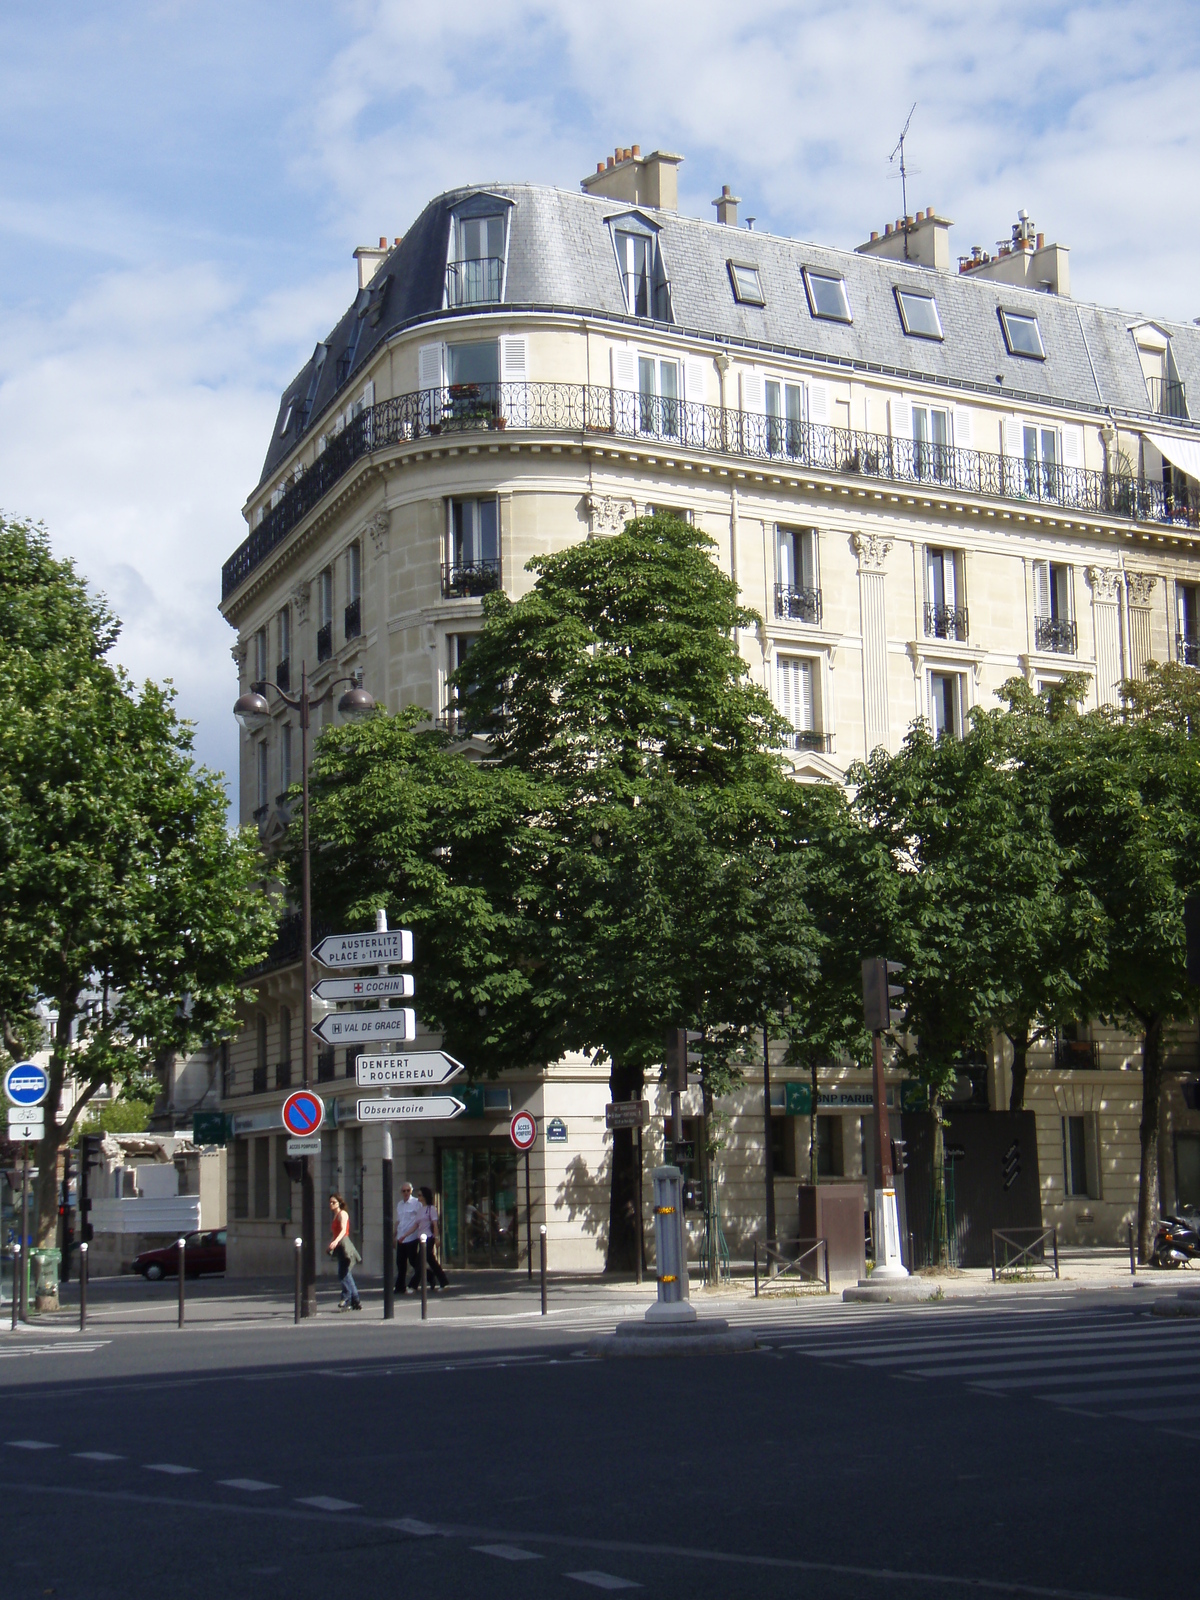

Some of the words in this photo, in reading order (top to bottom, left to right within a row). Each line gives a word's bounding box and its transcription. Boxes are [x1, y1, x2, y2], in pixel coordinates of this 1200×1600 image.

[341, 936, 398, 950] AUSTERLITZ
[329, 951, 358, 962] PLACE
[366, 981, 400, 992] COCHIN
[344, 1022, 360, 1032] VAL
[362, 1022, 373, 1031] DE
[375, 1020, 401, 1030] GRACE
[362, 1059, 409, 1069] DENFERT
[817, 1094, 838, 1103] BNP
[840, 1094, 874, 1103] PARIB
[364, 1104, 424, 1115] Observatoire
